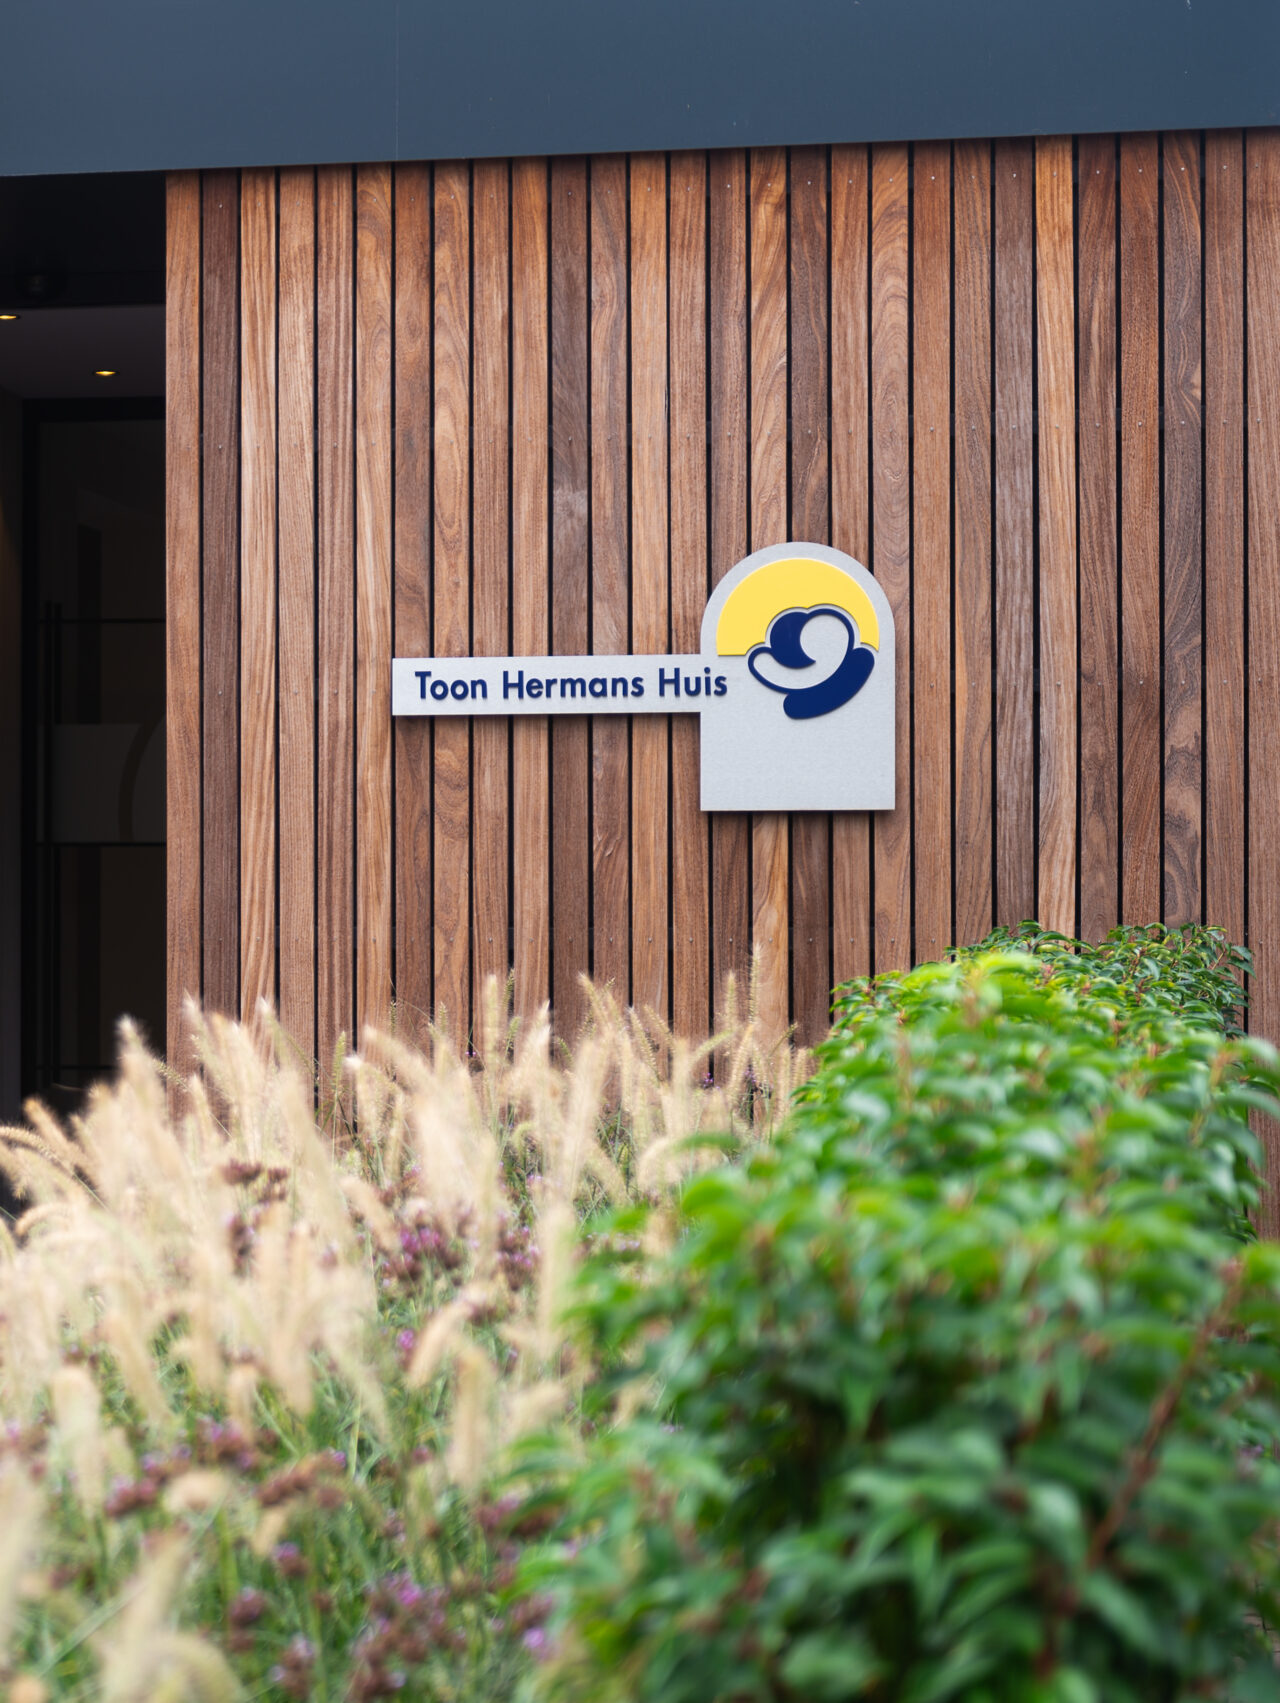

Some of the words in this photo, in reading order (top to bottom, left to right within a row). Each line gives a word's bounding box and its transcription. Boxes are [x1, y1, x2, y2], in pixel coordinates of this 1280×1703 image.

[414, 670, 488, 701] Toon
[502, 670, 645, 700] Hermans
[658, 666, 728, 697] Huis
